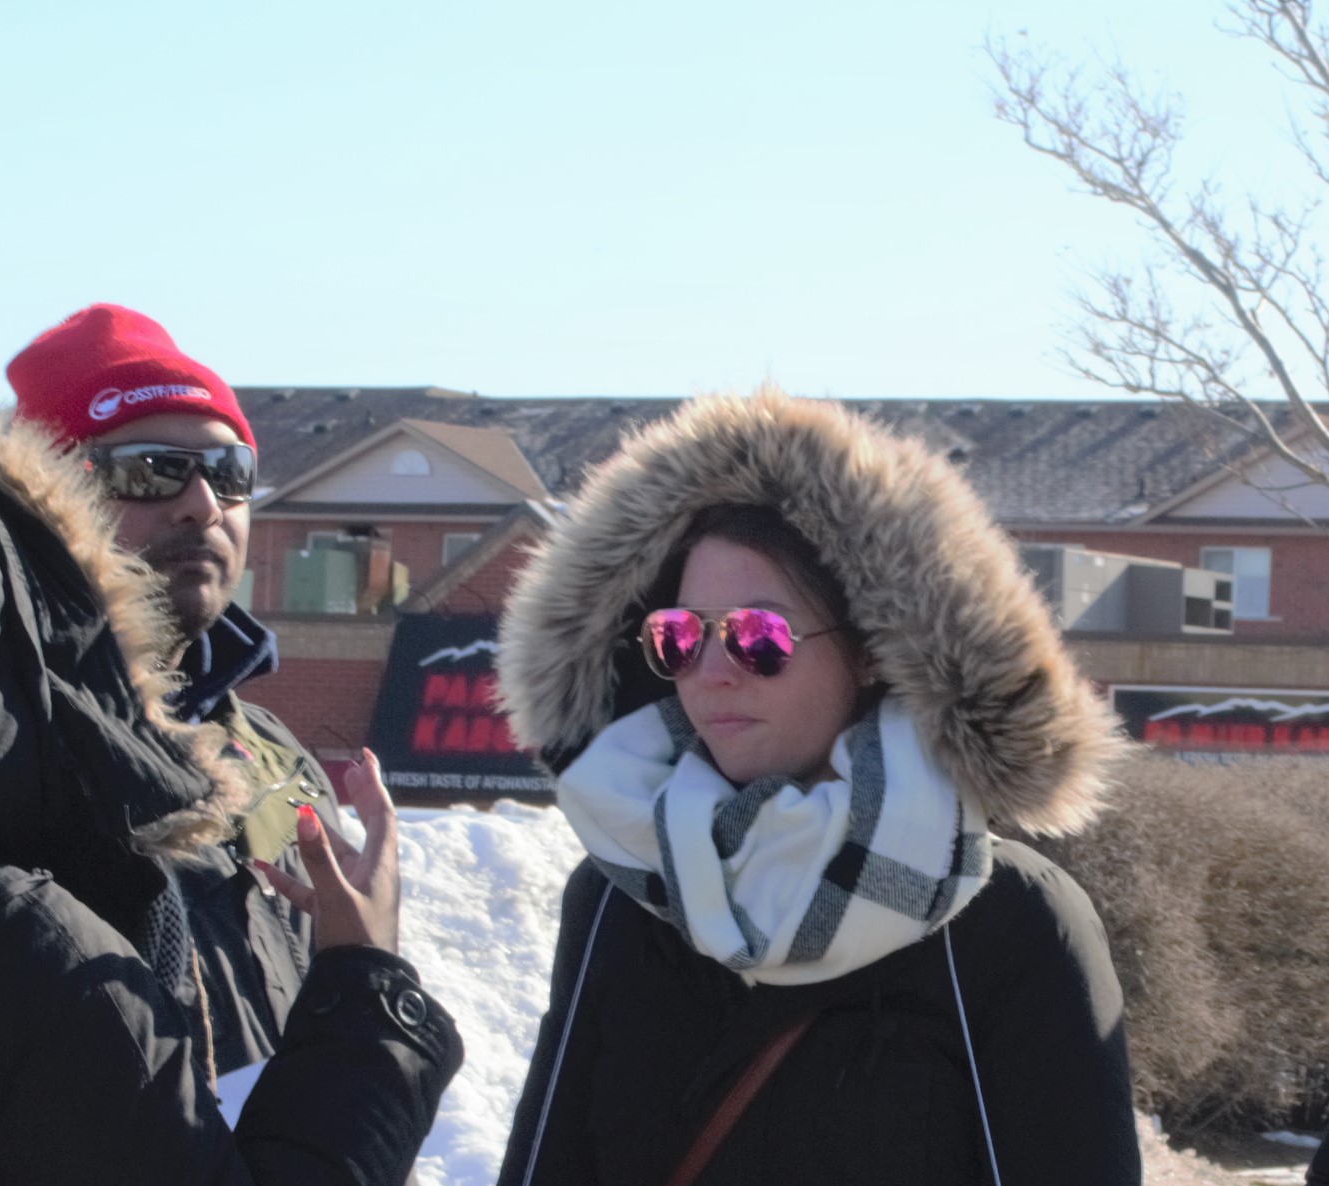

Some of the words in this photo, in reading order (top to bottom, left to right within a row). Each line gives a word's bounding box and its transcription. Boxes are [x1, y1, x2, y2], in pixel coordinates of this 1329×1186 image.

[390, 771, 428, 787] FRESH
[429, 773, 464, 788] TASTE
[465, 774, 482, 789] OF
[483, 775, 559, 791] AFGHANISTA
